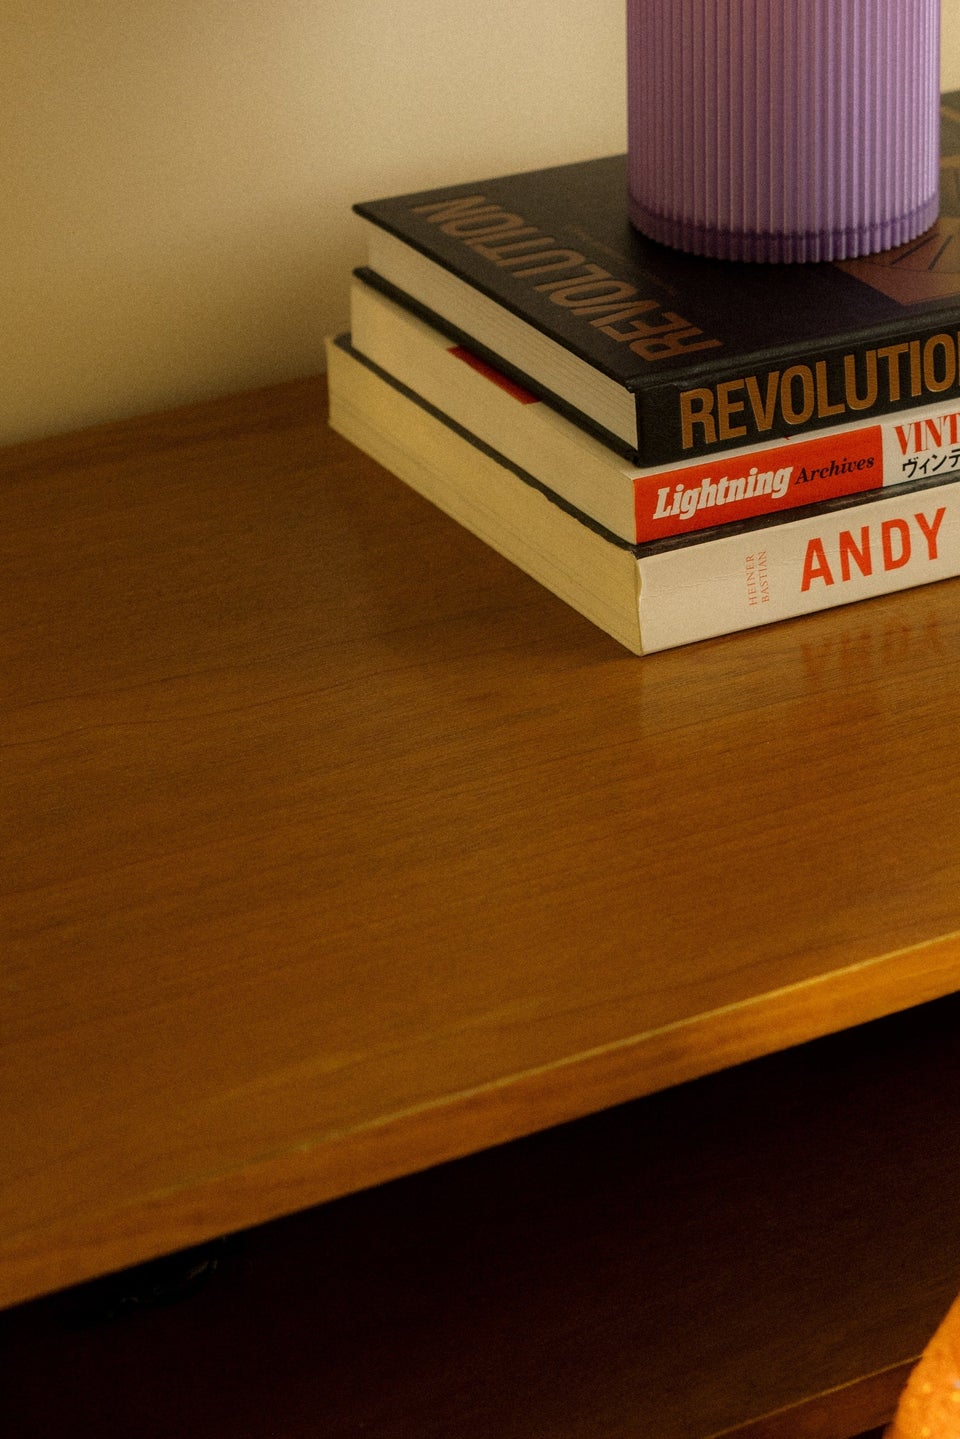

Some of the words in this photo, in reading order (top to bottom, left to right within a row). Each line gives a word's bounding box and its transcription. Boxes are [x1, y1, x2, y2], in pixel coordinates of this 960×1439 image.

[412, 195, 722, 362] REVOLUTION
[652, 466, 794, 520] Lightning
[795, 456, 875, 485] Archives
[746, 554, 758, 607] HEINER
[757, 550, 770, 603] BASTIAN
[800, 507, 947, 592] ANDY
